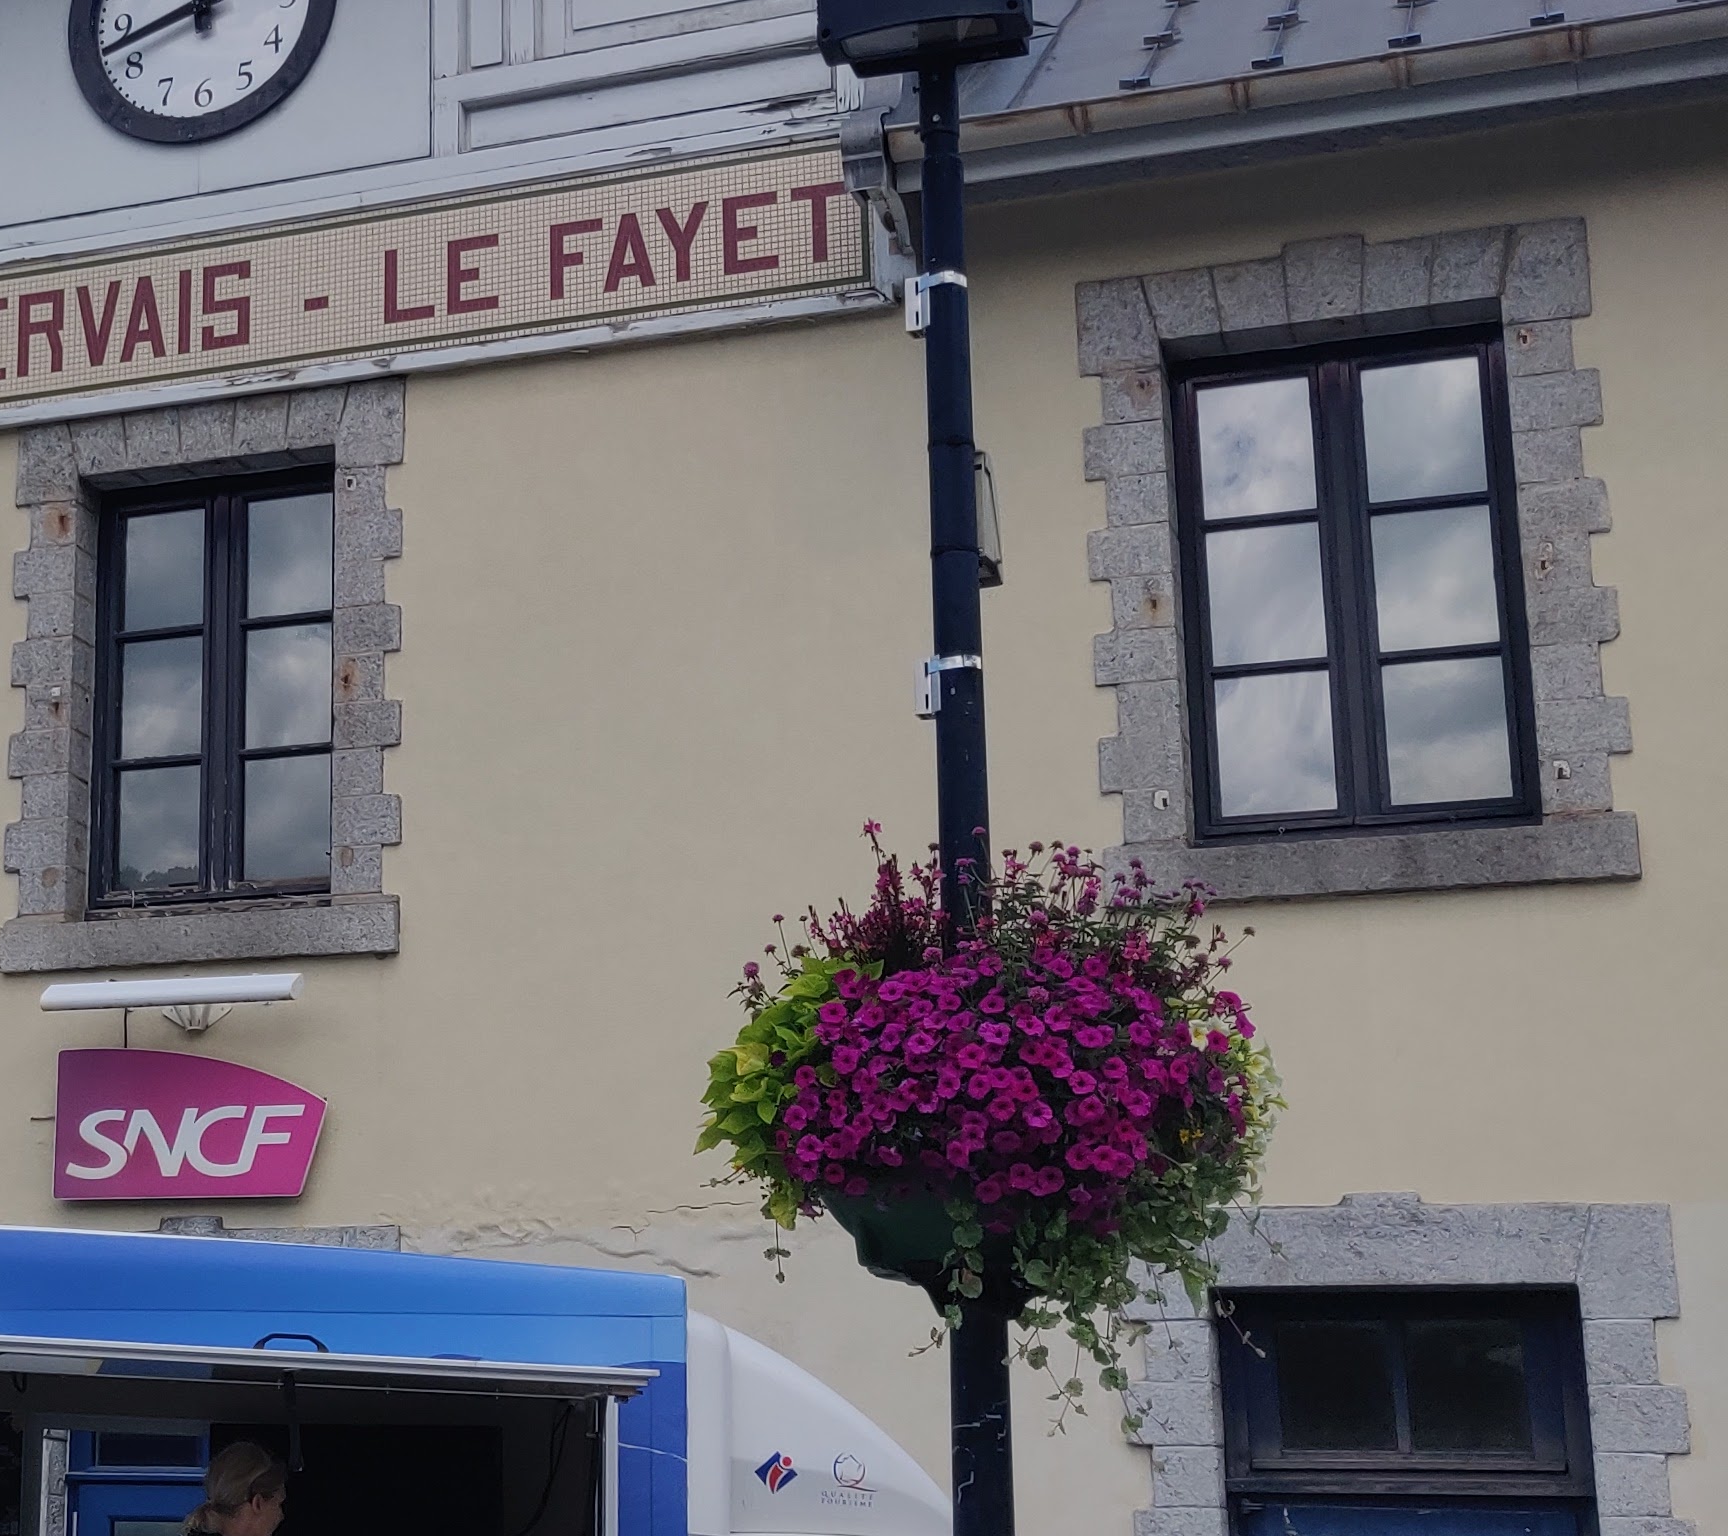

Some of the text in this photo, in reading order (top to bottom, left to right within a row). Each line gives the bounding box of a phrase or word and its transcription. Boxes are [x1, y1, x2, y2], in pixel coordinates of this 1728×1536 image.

[113, 13, 134, 37] 9
[263, 24, 284, 54] 4
[124, 51, 144, 79] 8
[235, 60, 254, 91] 5
[156, 76, 174, 107] 7
[193, 77, 213, 108] 6
[383, 232, 500, 325] LE
[548, 181, 848, 302] FAYET
[65, 1104, 306, 1180] SNCF
